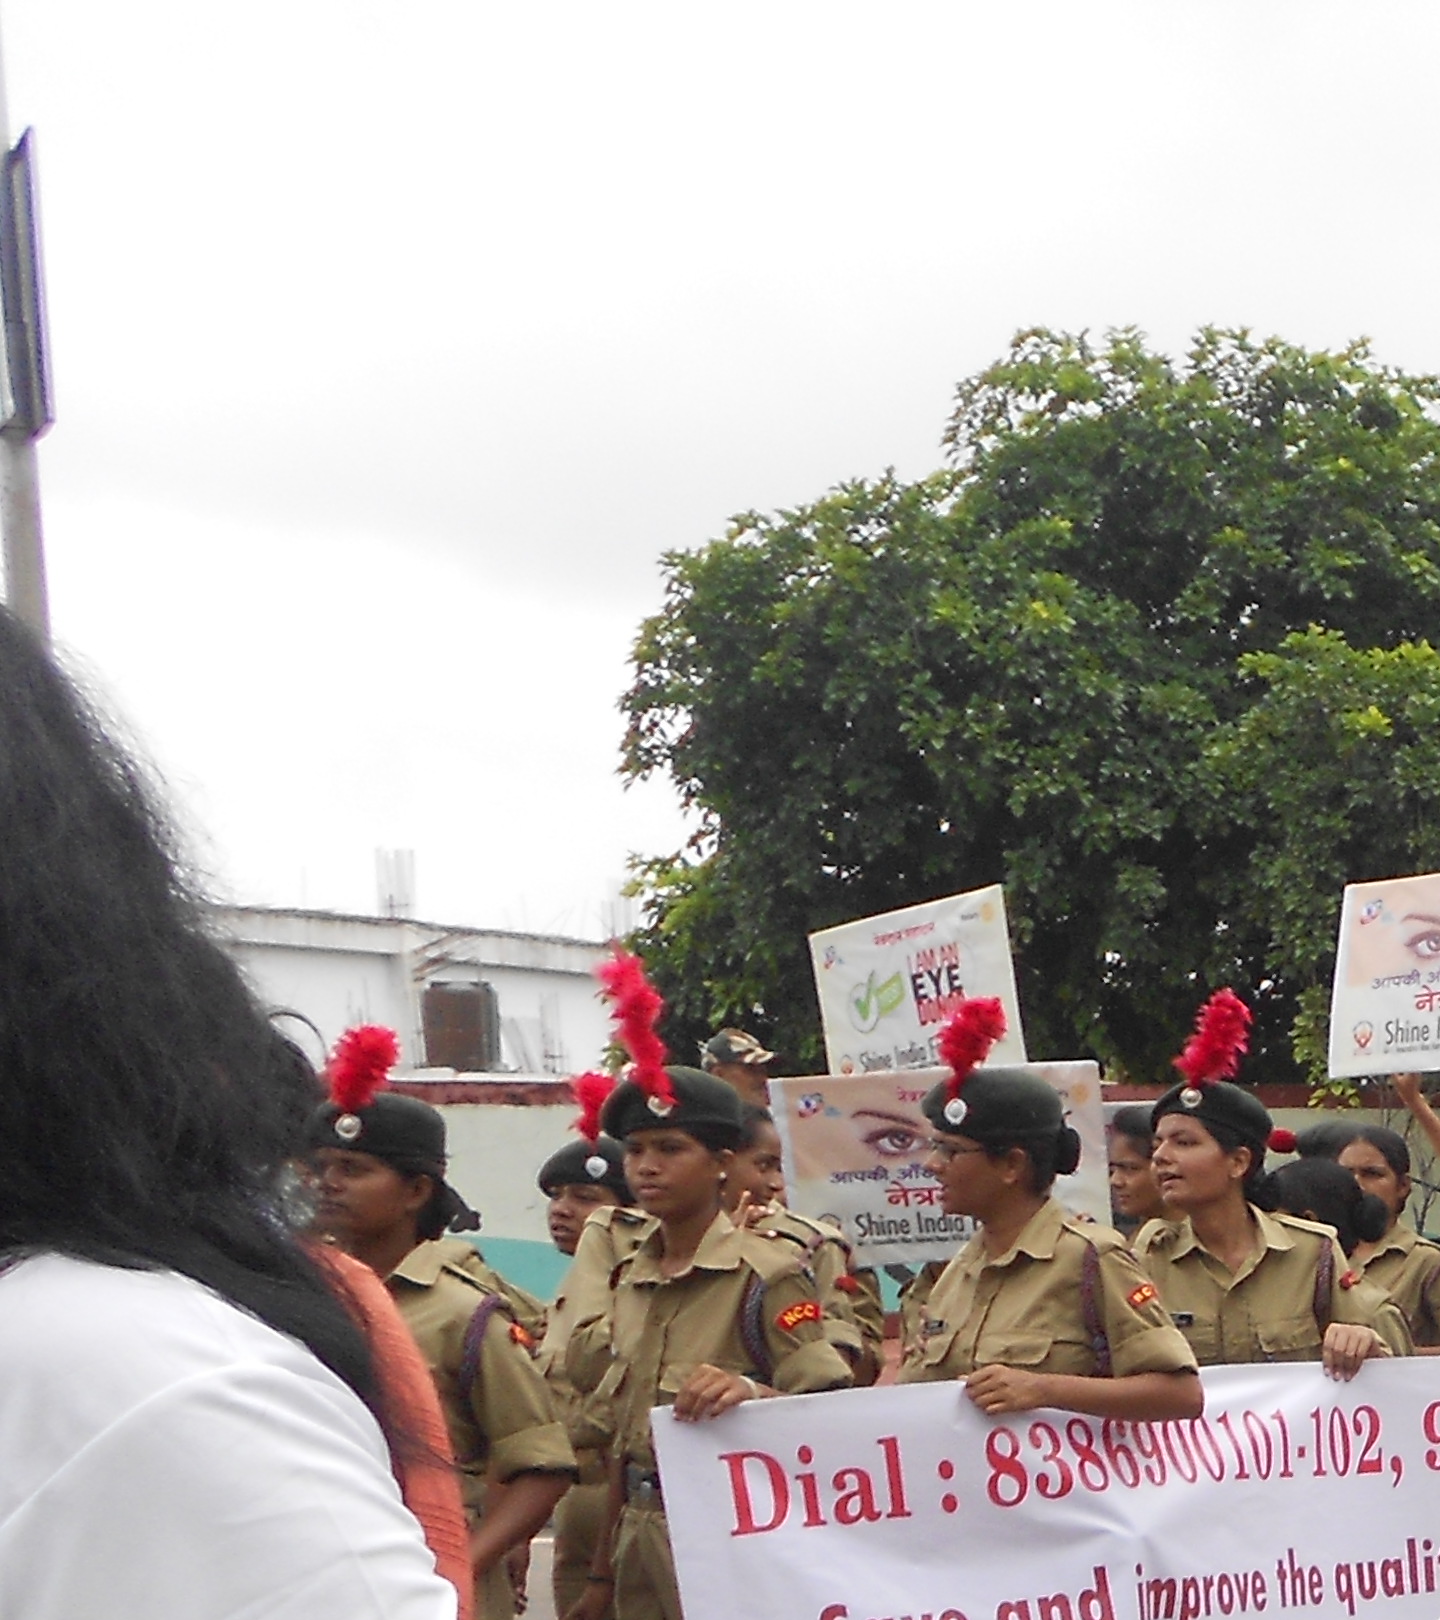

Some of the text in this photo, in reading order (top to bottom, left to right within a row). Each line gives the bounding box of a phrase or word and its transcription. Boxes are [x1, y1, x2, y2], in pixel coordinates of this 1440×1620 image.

[911, 963, 963, 1000] EYE
[1372, 968, 1420, 990] आपकी
[1384, 1018, 1430, 1046] Shine
[830, 1164, 888, 1184] आपकी
[854, 1211, 911, 1238] Shine
[916, 1211, 965, 1235] India
[782, 1303, 816, 1327] NCC
[717, 1434, 912, 1537] Dial
[1275, 1546, 1324, 1608] the
